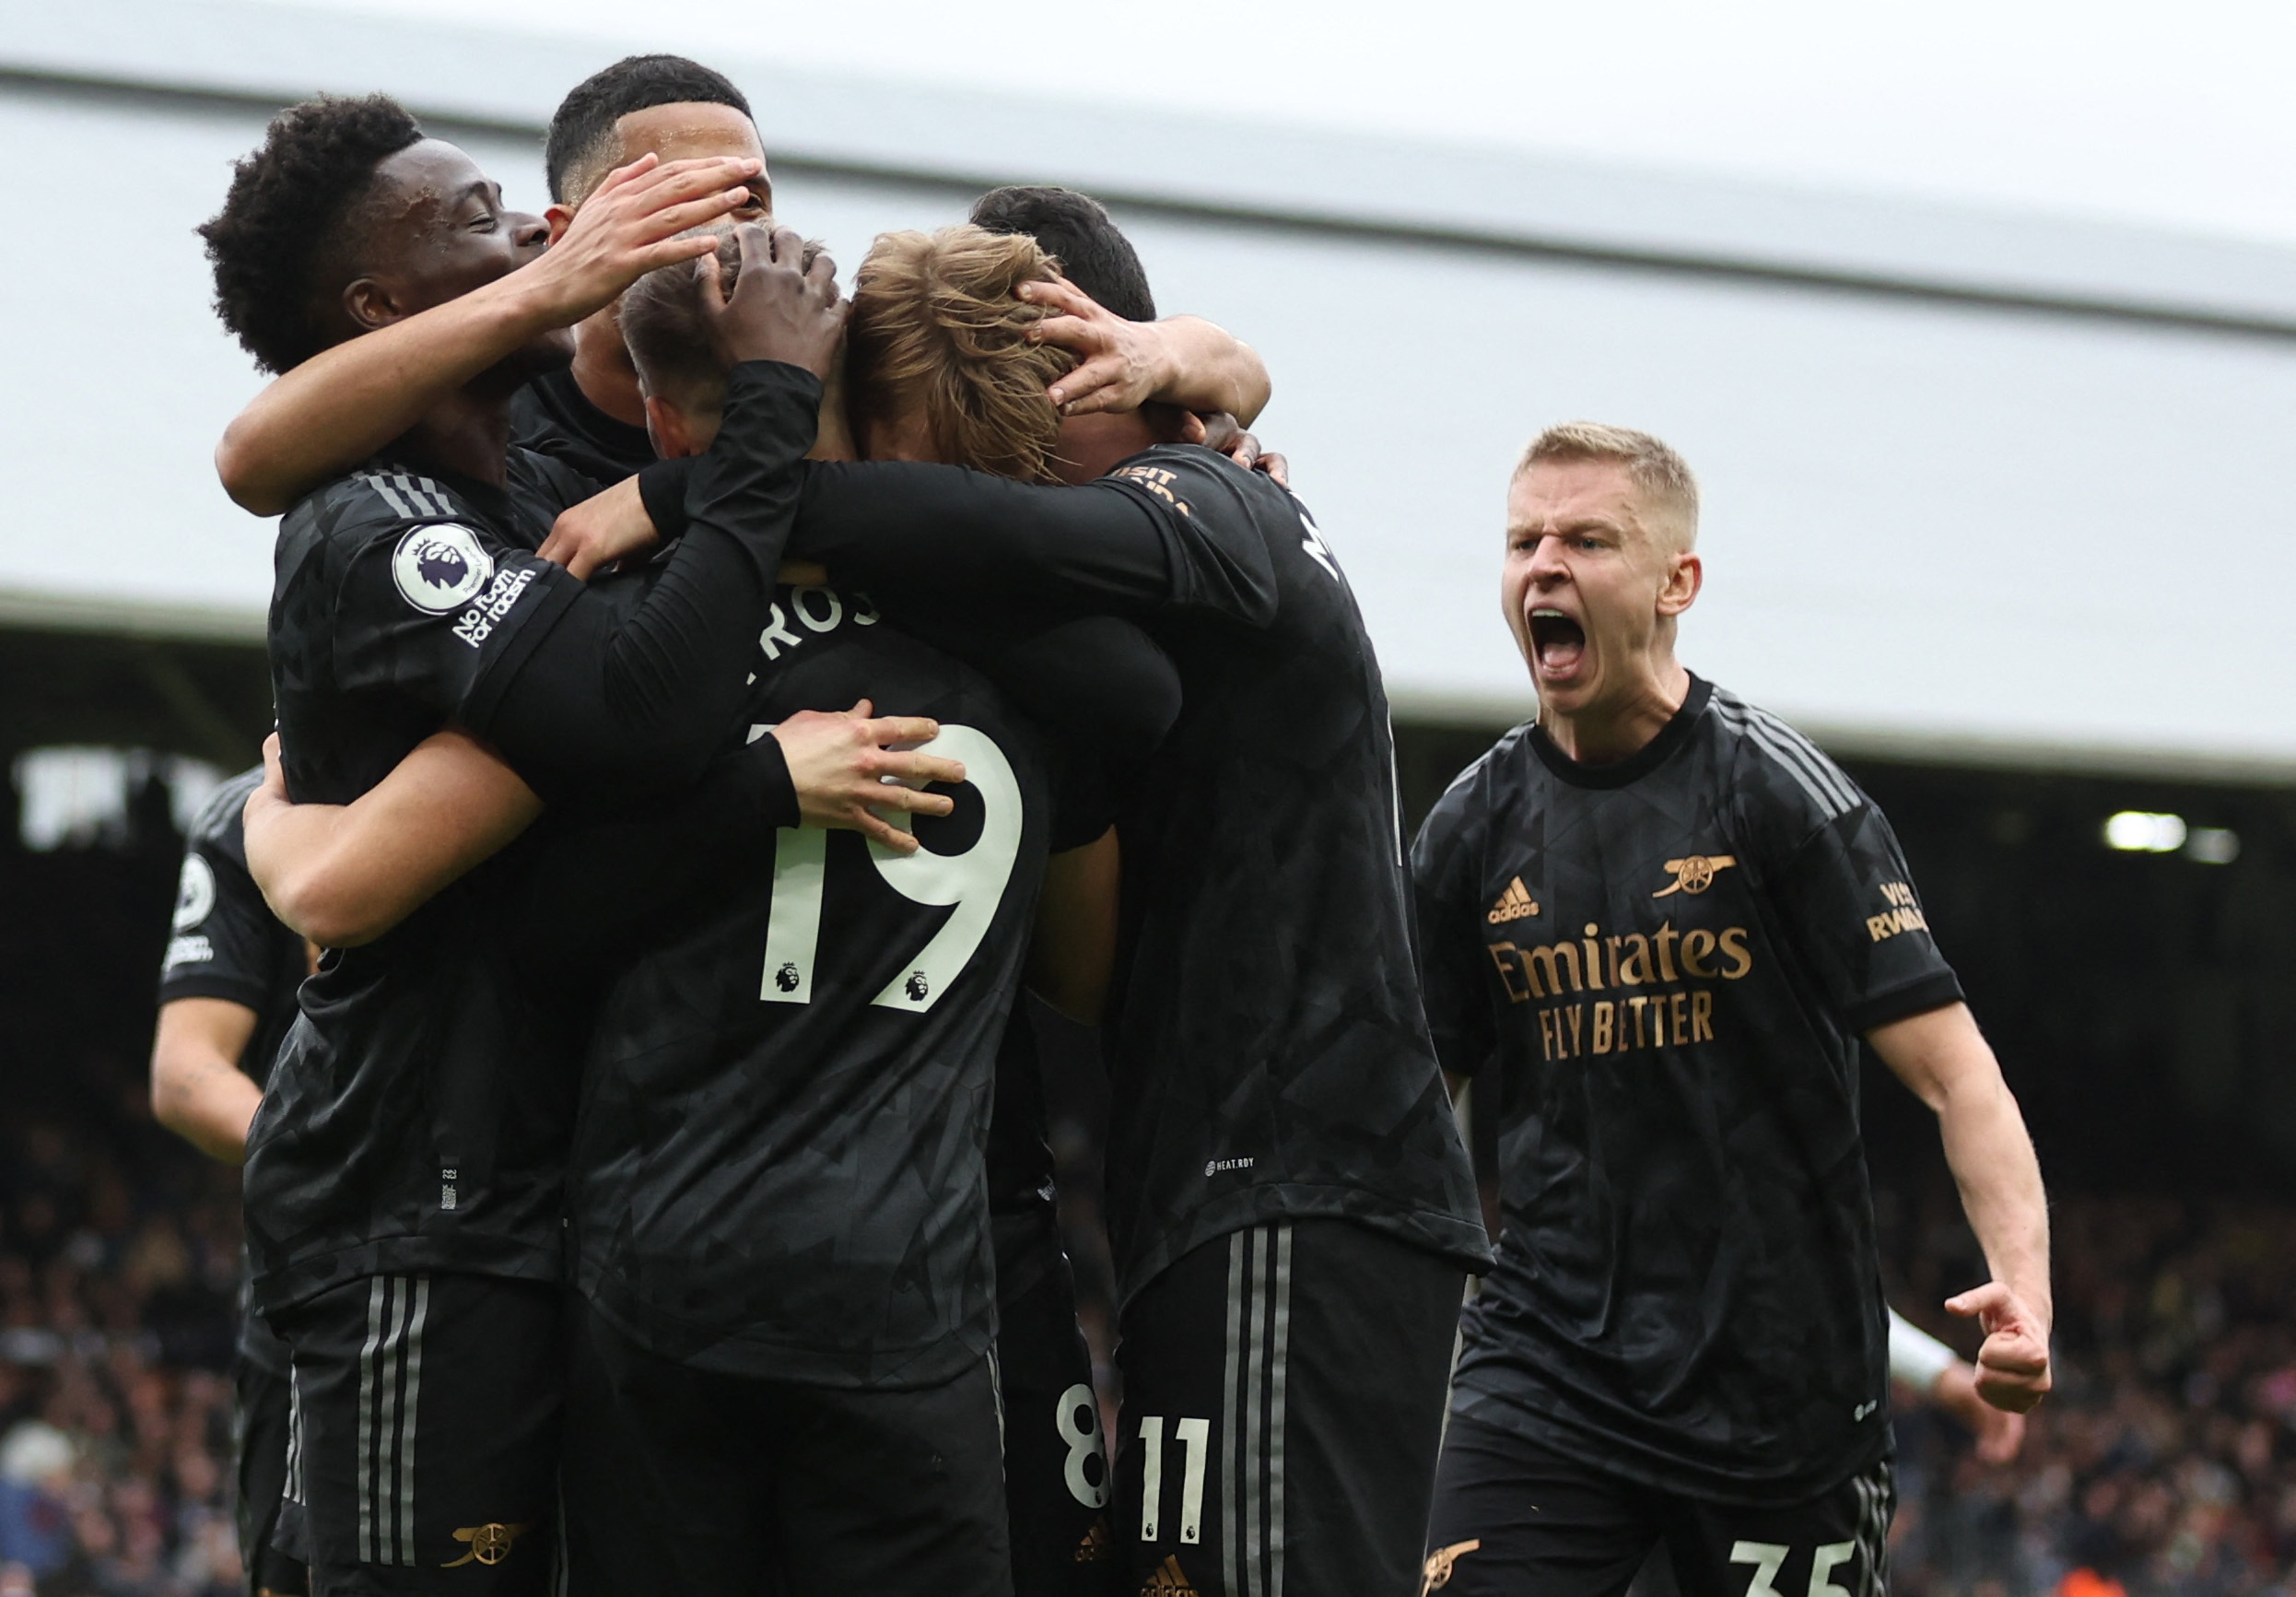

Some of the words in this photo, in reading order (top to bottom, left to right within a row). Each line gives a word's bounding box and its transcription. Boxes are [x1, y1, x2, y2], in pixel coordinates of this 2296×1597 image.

[451, 609, 481, 640] No
[474, 569, 517, 611] room
[486, 569, 537, 623] racism
[746, 724, 1023, 1013] 19
[1487, 900, 1540, 924] adidas
[1487, 920, 1752, 1004] Emirates
[1539, 1004, 1582, 1061] FLY
[1593, 990, 1714, 1054] BETTER
[1056, 1383, 1111, 1509] 8
[1139, 1416, 1210, 1544] 11
